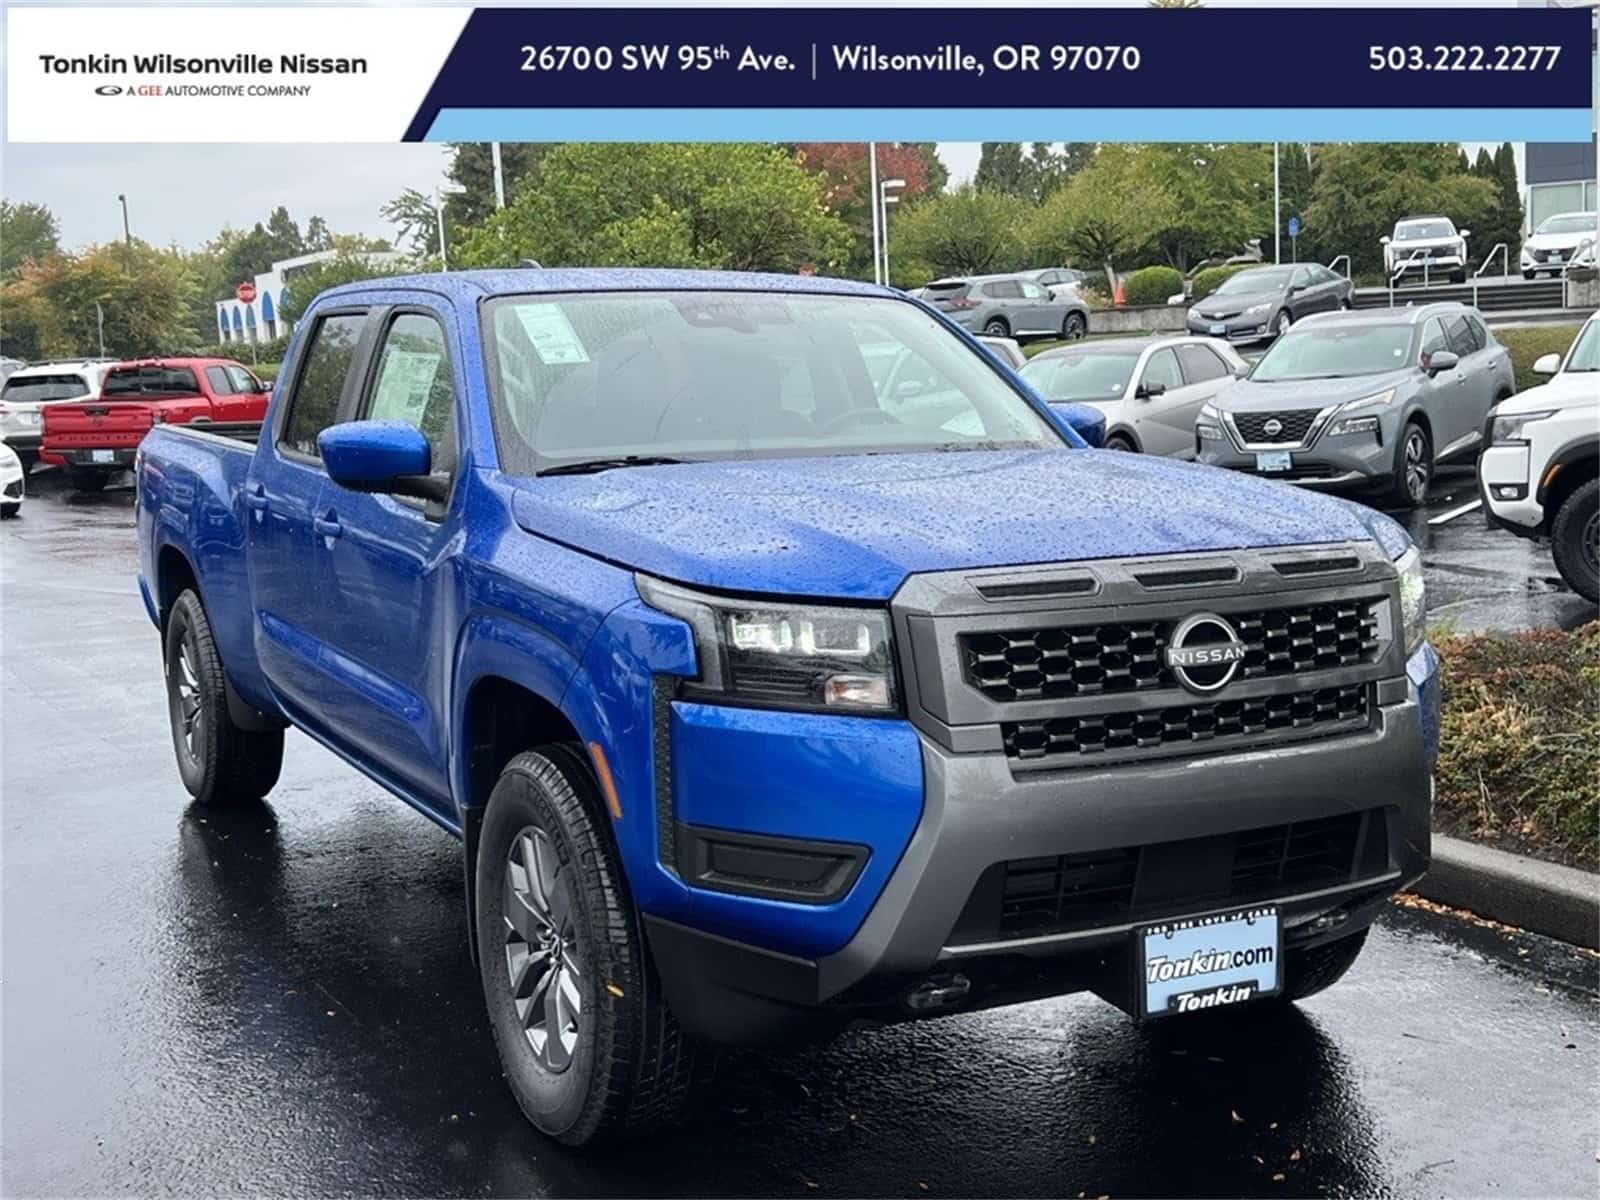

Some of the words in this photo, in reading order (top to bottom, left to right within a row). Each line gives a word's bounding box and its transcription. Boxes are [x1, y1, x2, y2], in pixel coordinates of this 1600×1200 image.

[1171, 647, 1245, 664] NISSAN
[1148, 947, 1273, 983] Tonkin.com
[1177, 985, 1251, 1013] Tonkin
